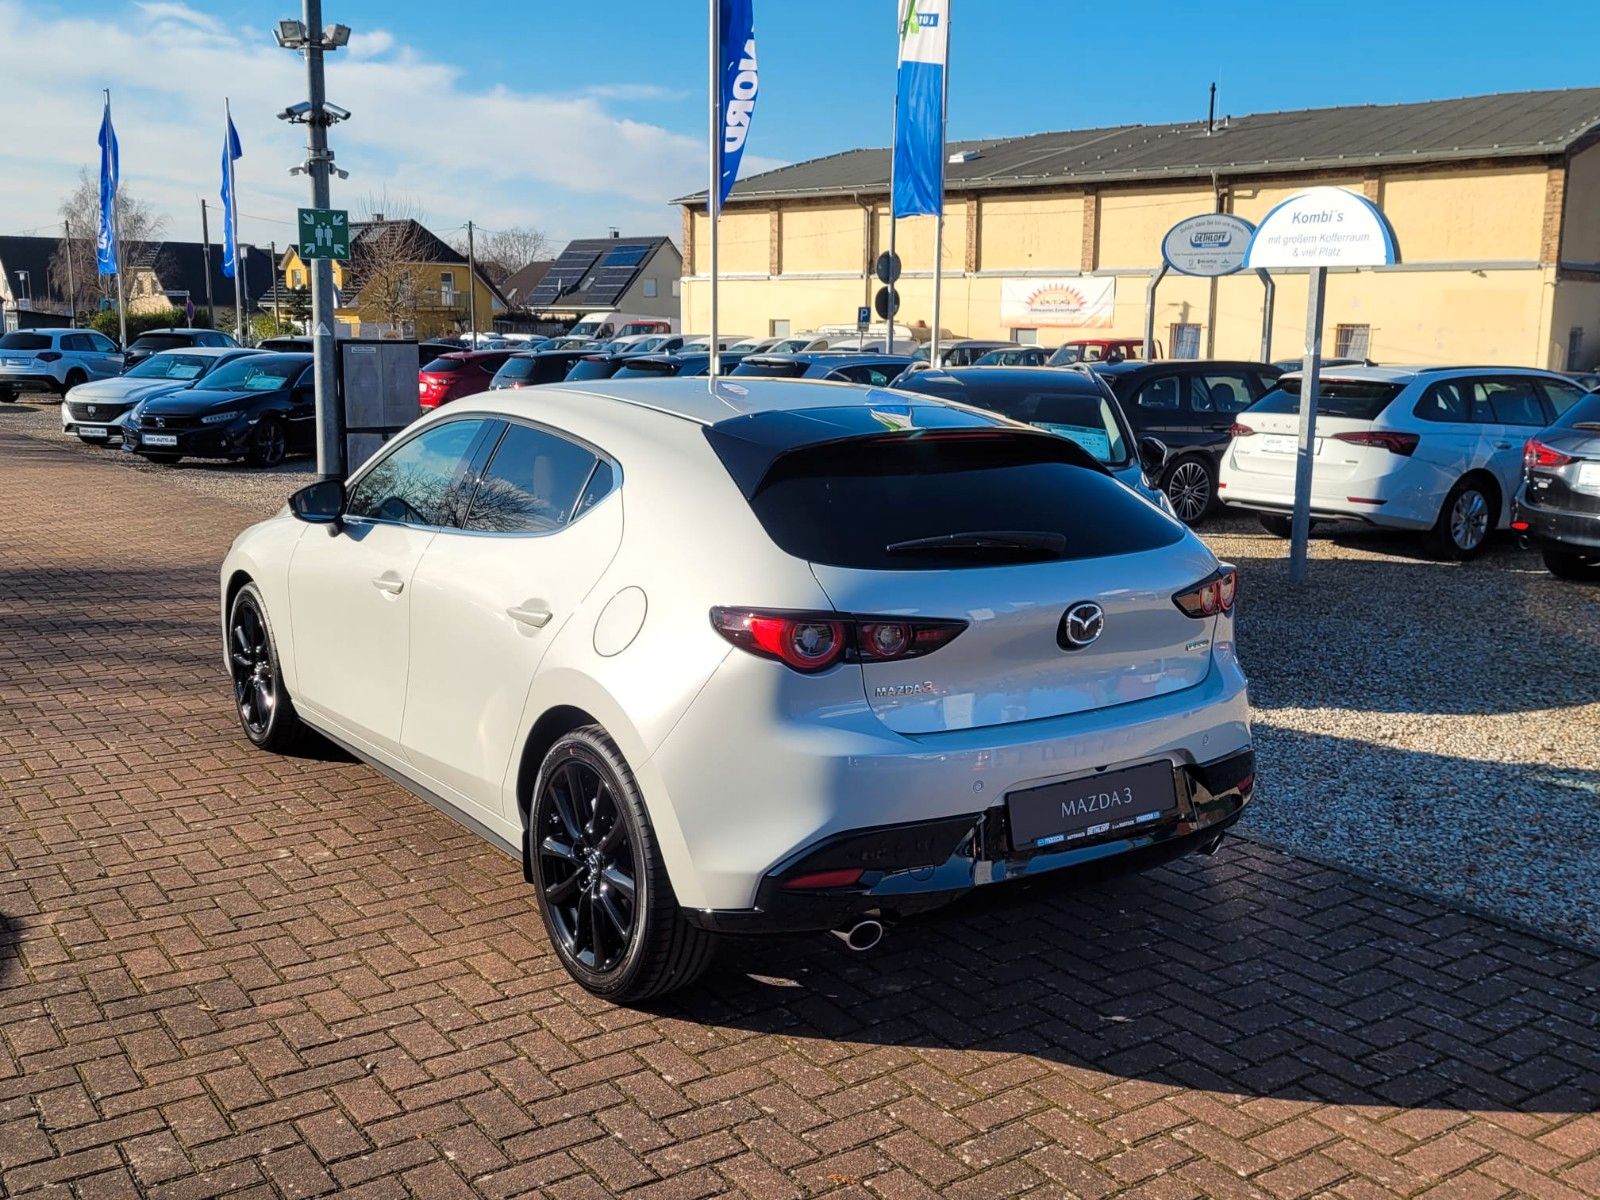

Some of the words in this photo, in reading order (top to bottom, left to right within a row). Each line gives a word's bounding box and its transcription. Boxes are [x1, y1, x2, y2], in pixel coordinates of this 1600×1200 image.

[1268, 234, 1281, 244] mit
[1283, 233, 1317, 246] großem
[1319, 232, 1370, 243] Kofferraum
[1302, 248, 1317, 257] viel
[1319, 247, 1341, 257] Platz
[860, 308, 868, 322] P
